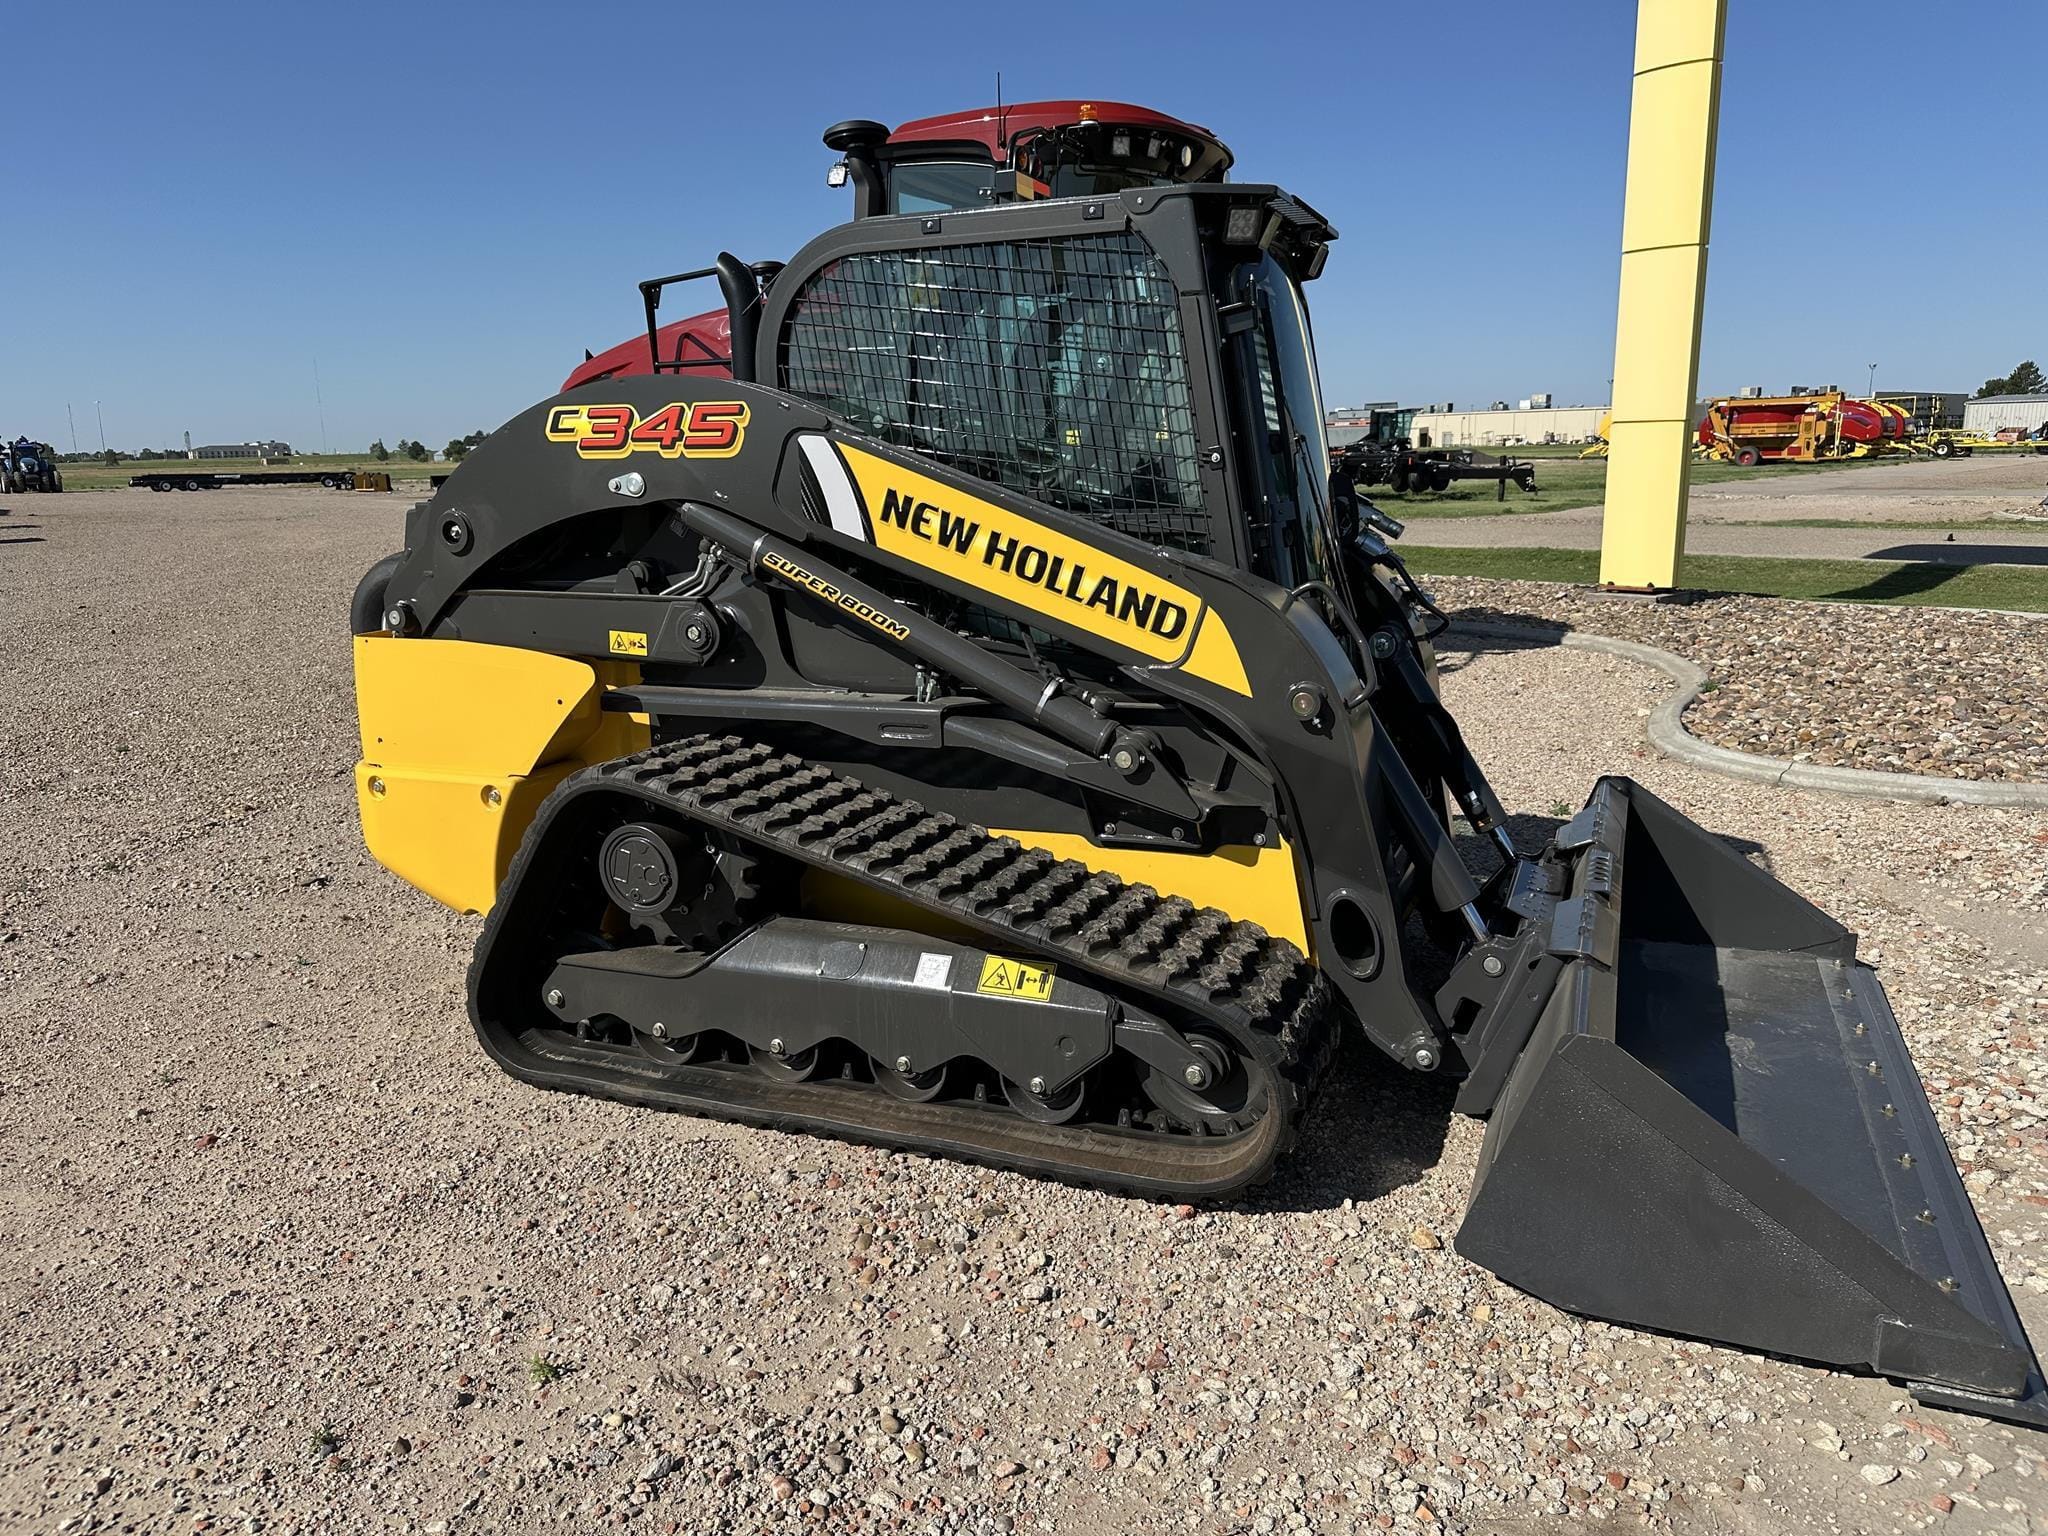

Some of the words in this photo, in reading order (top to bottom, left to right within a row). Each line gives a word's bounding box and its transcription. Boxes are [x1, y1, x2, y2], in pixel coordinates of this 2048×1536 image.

[546, 402, 750, 459] C345
[763, 552, 840, 603] SUPER
[839, 594, 911, 641] BOOM
[880, 488, 979, 555] NEW
[983, 530, 1188, 641] HOLLAND
